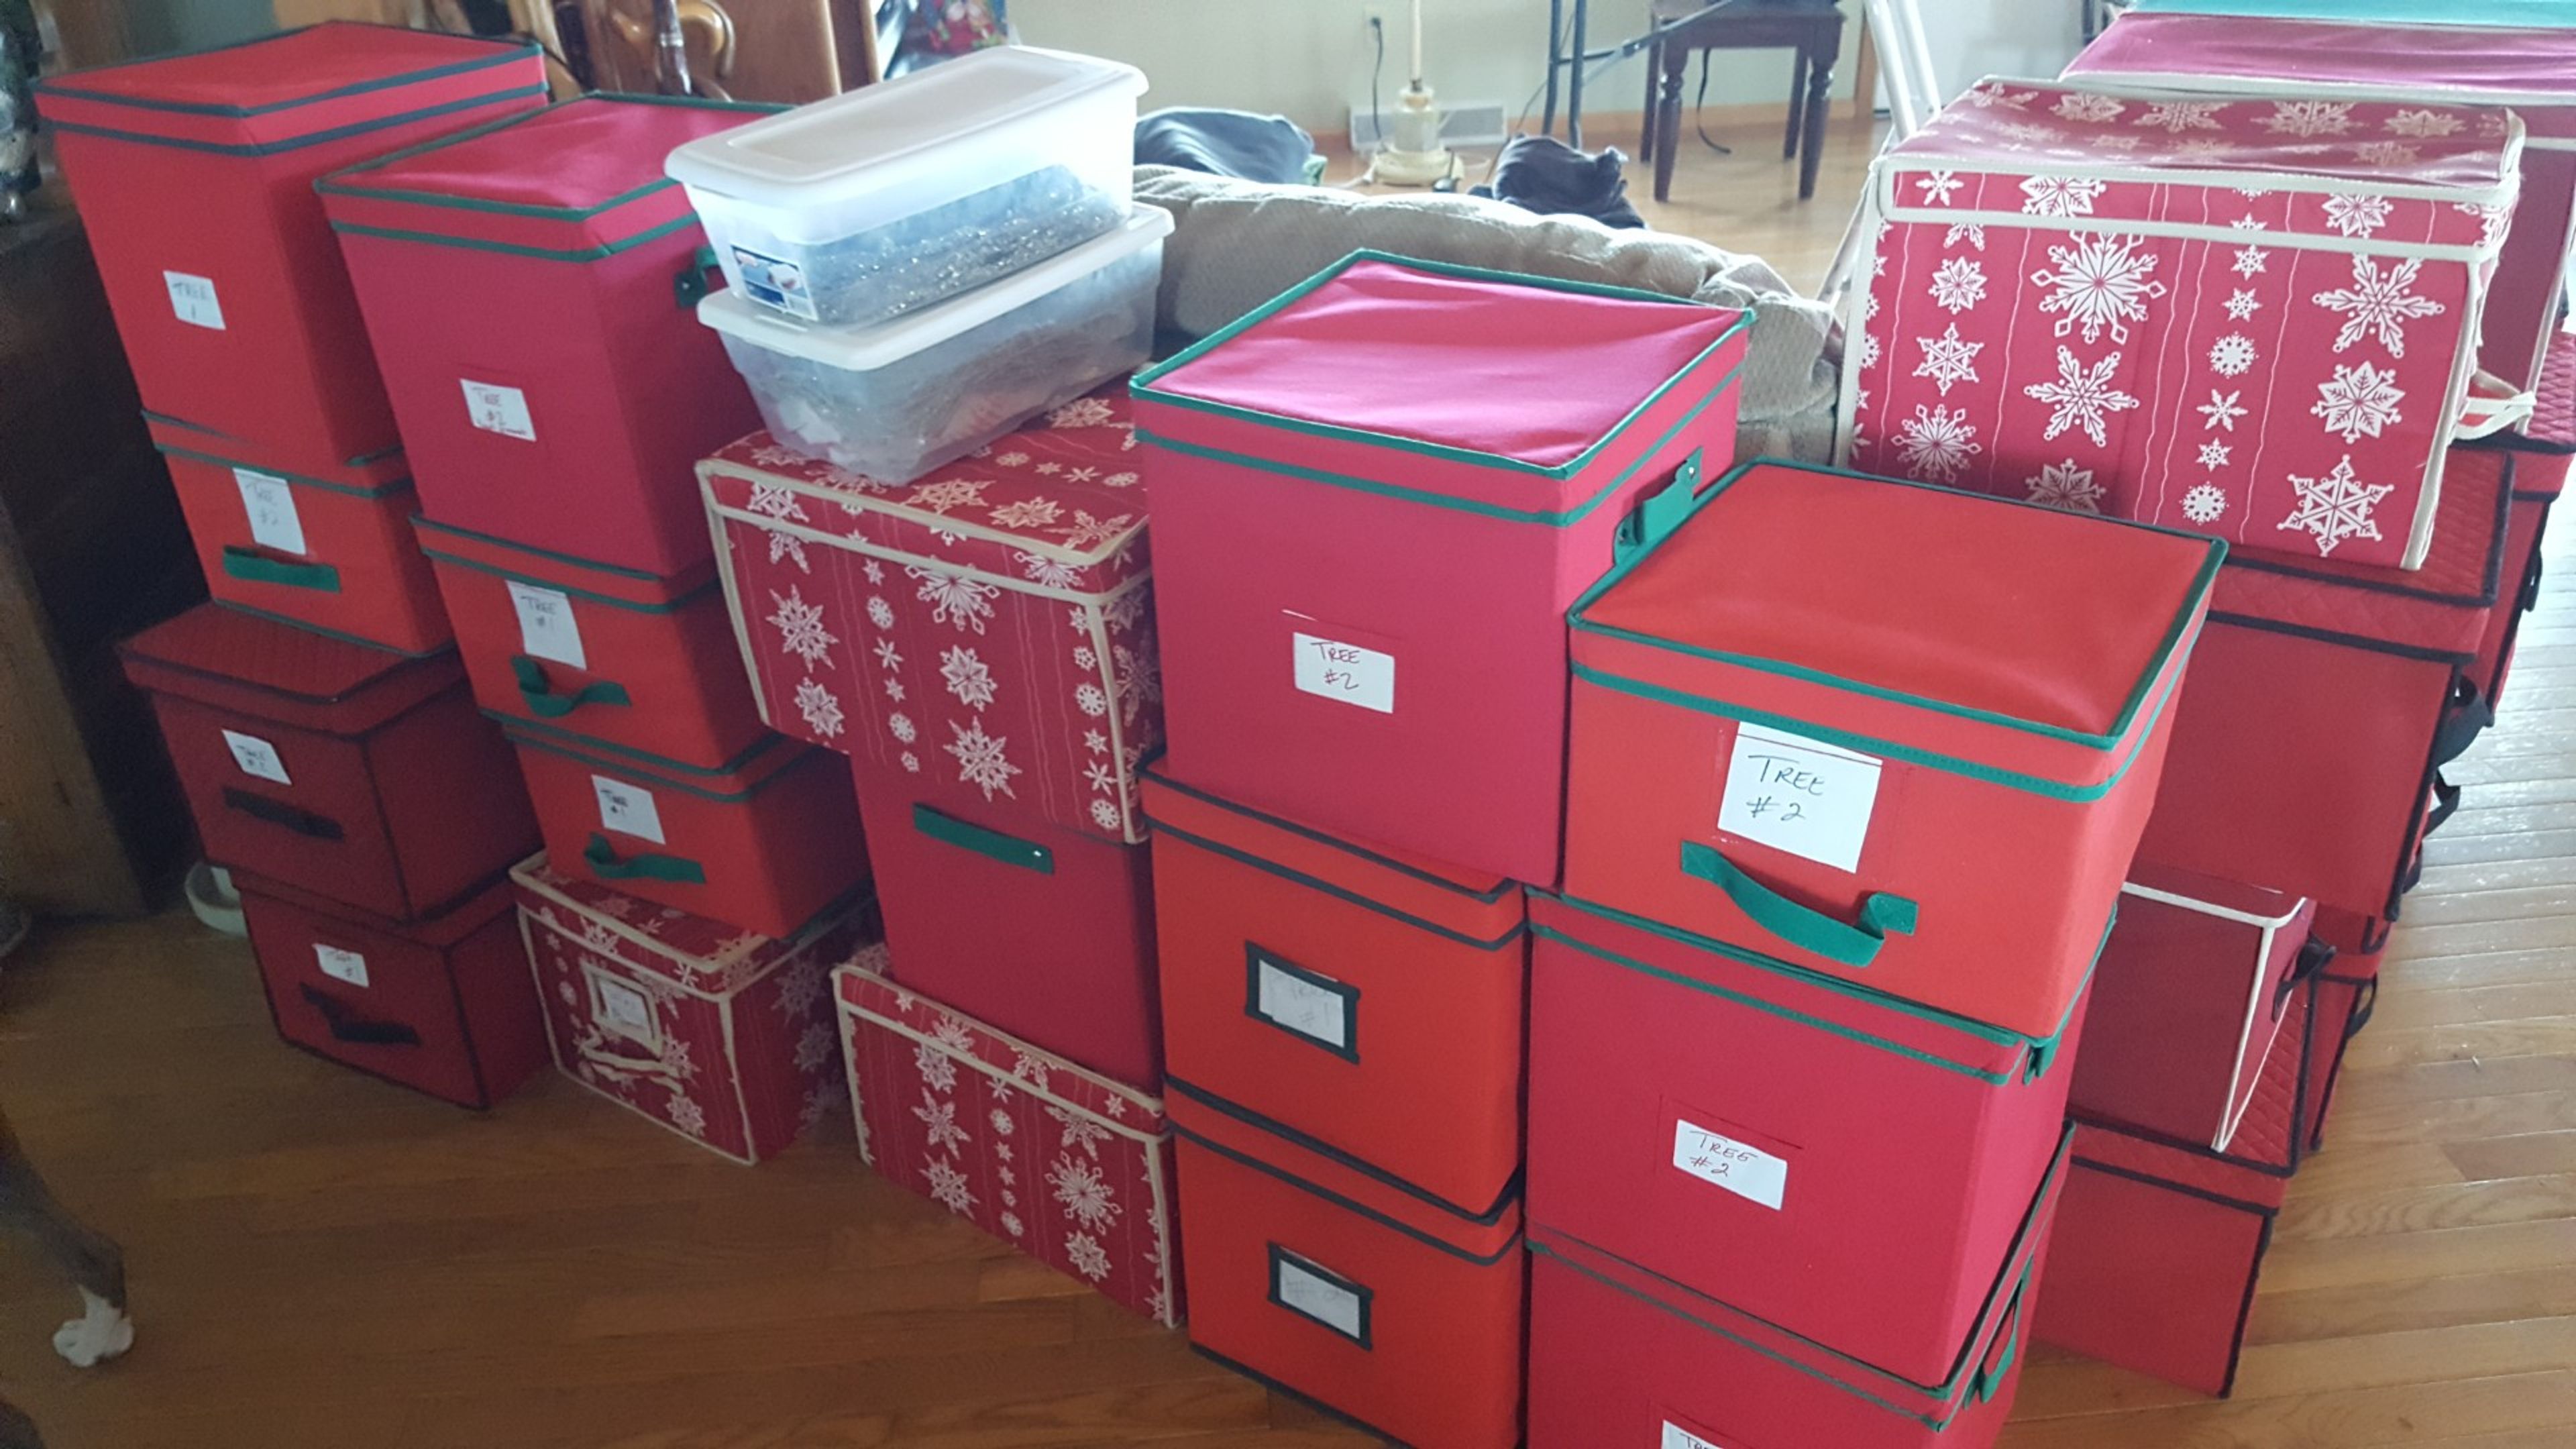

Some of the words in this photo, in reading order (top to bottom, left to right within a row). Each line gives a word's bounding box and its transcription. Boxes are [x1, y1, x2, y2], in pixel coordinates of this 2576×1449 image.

[1309, 641, 1360, 663] TREE
[1324, 668, 1359, 690] #2
[1748, 754, 1825, 796] TREE
[1746, 796, 1807, 821] #2
[1689, 1130, 1759, 1162] TREE
[1688, 1156, 1729, 1177] #2
